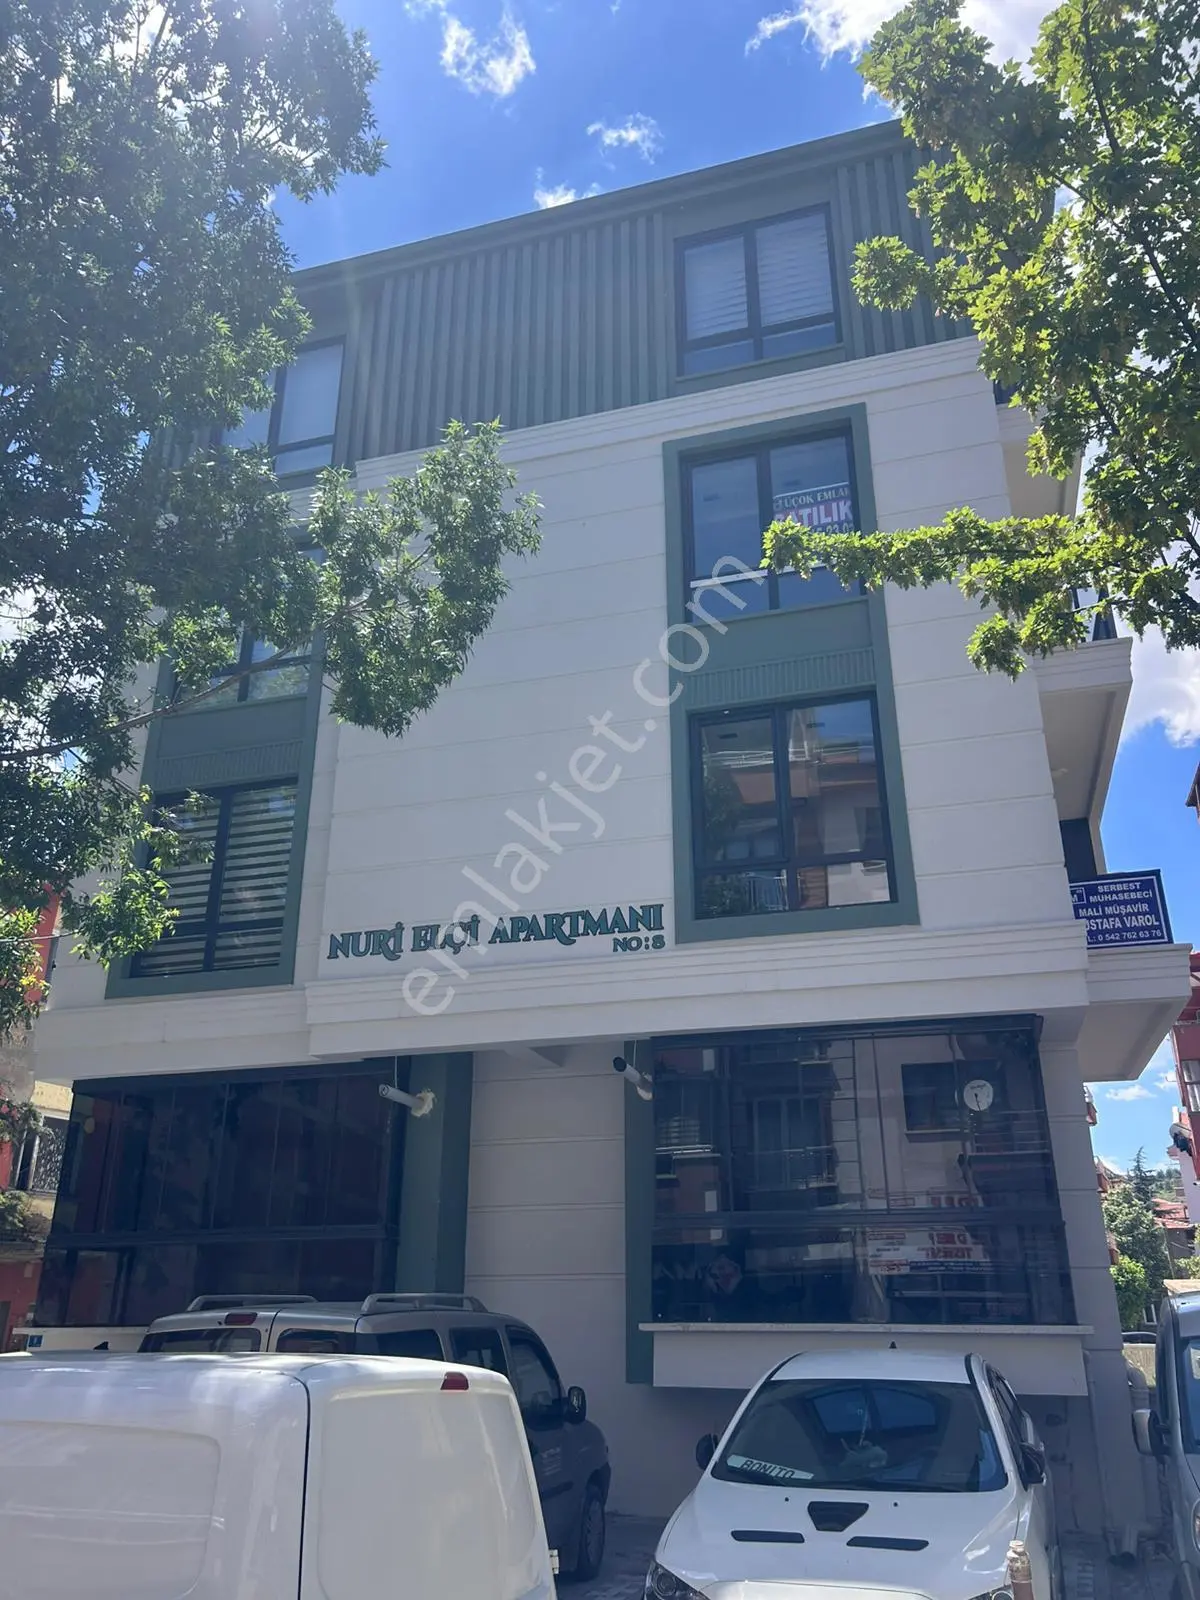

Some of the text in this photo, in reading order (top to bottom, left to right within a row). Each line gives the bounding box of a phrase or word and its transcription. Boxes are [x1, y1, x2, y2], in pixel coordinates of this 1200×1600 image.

[1097, 882, 1141, 893] SERBEST
[1079, 902, 1149, 917] MALİ MÜŞAVİR
[1123, 914, 1159, 928] VAROL
[327, 921, 405, 961] NURİ
[488, 903, 665, 946] APARTMANI
[740, 1459, 796, 1479] BONITO
